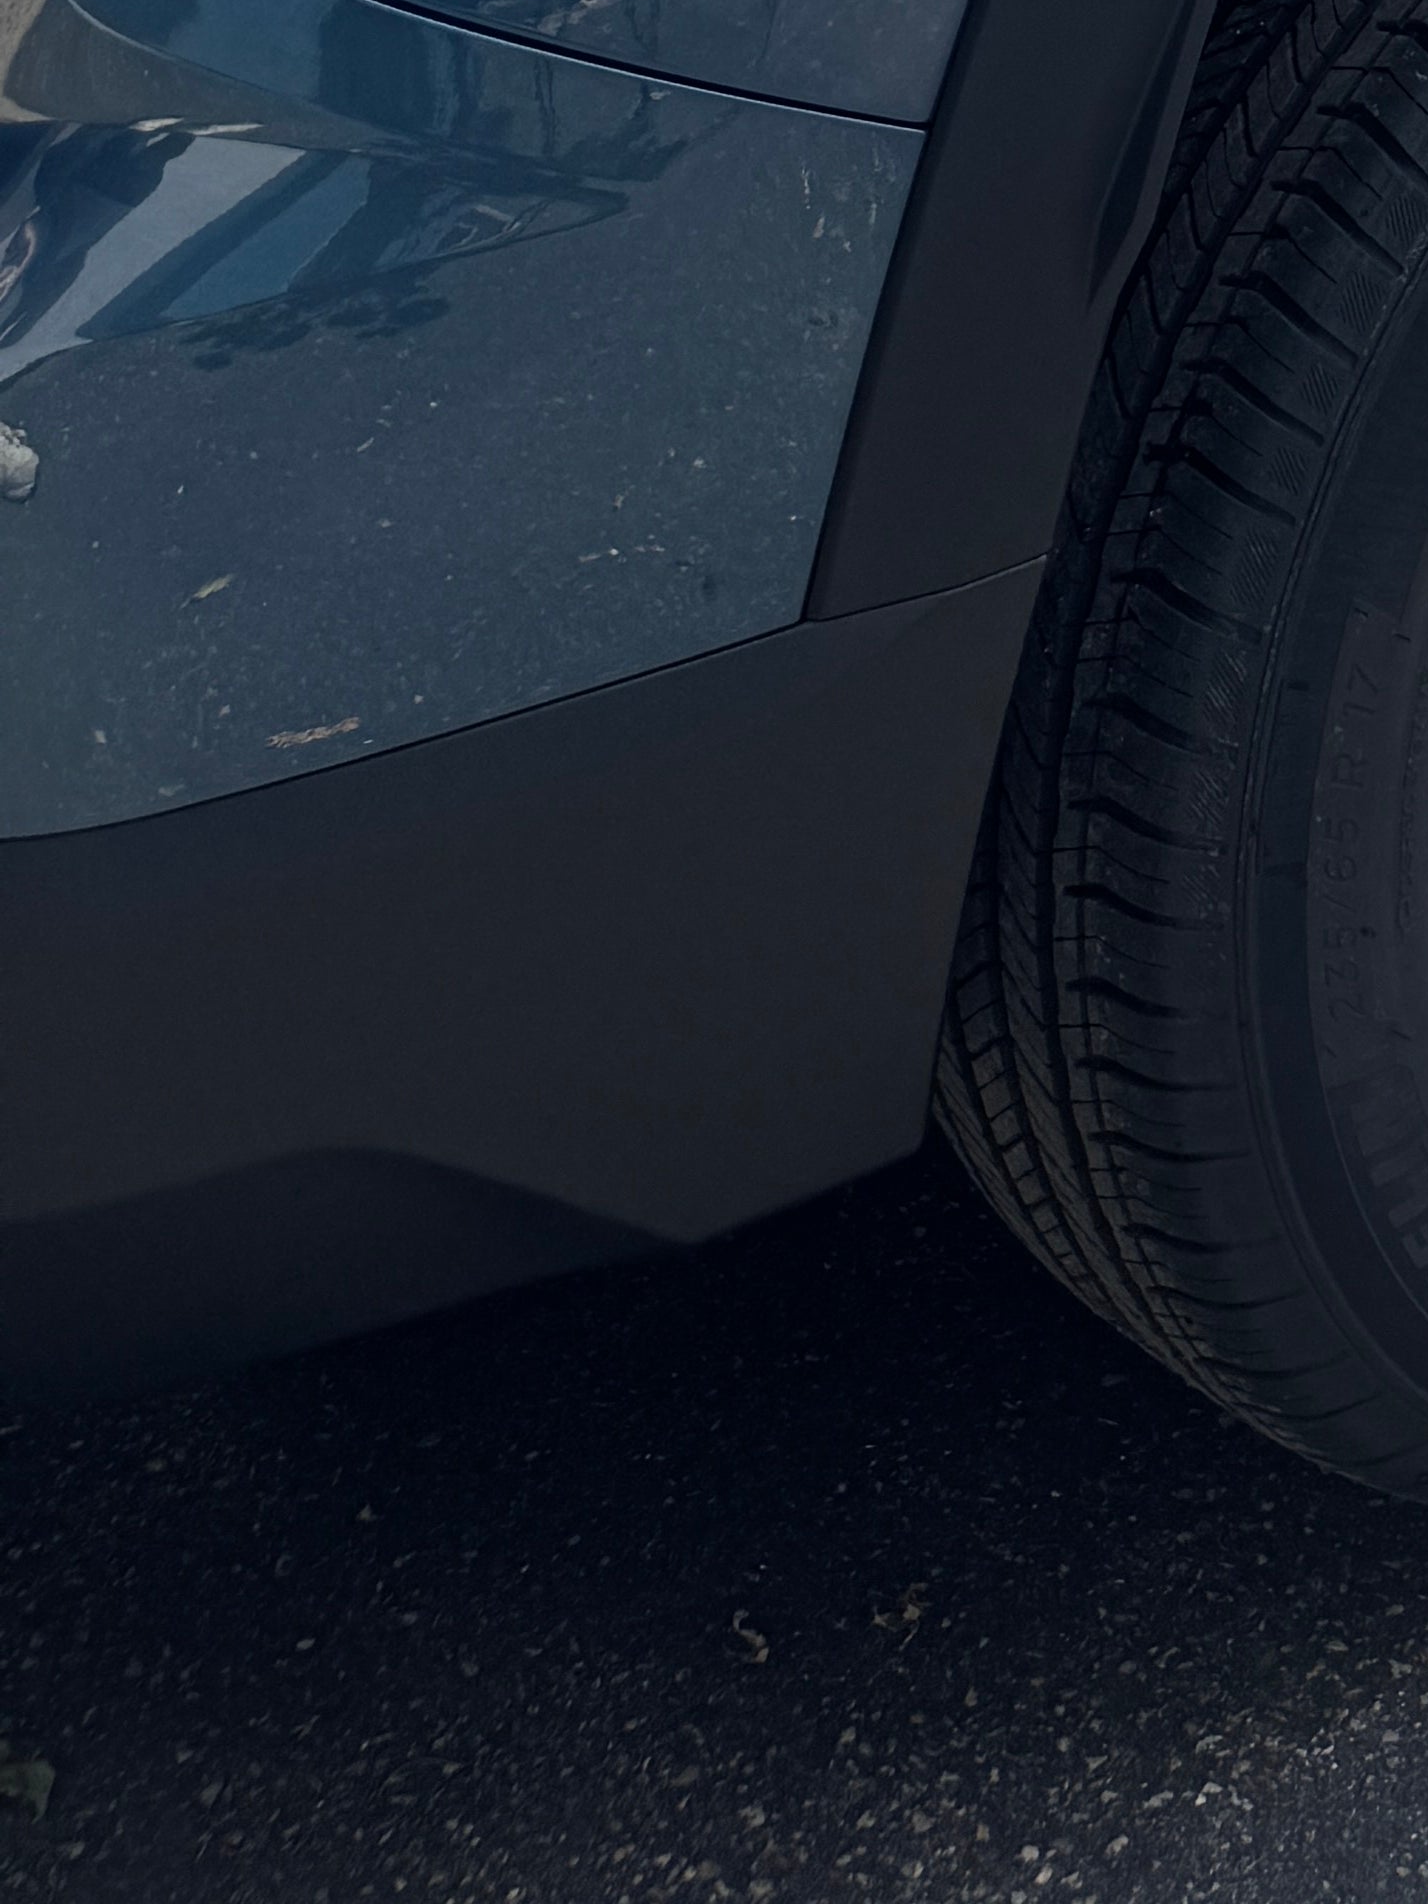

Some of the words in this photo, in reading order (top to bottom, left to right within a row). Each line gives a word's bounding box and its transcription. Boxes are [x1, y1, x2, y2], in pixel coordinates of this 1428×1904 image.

[1343, 663, 1379, 717] 17
[1331, 753, 1370, 788] R
[1322, 817, 1368, 1023] 235/65
